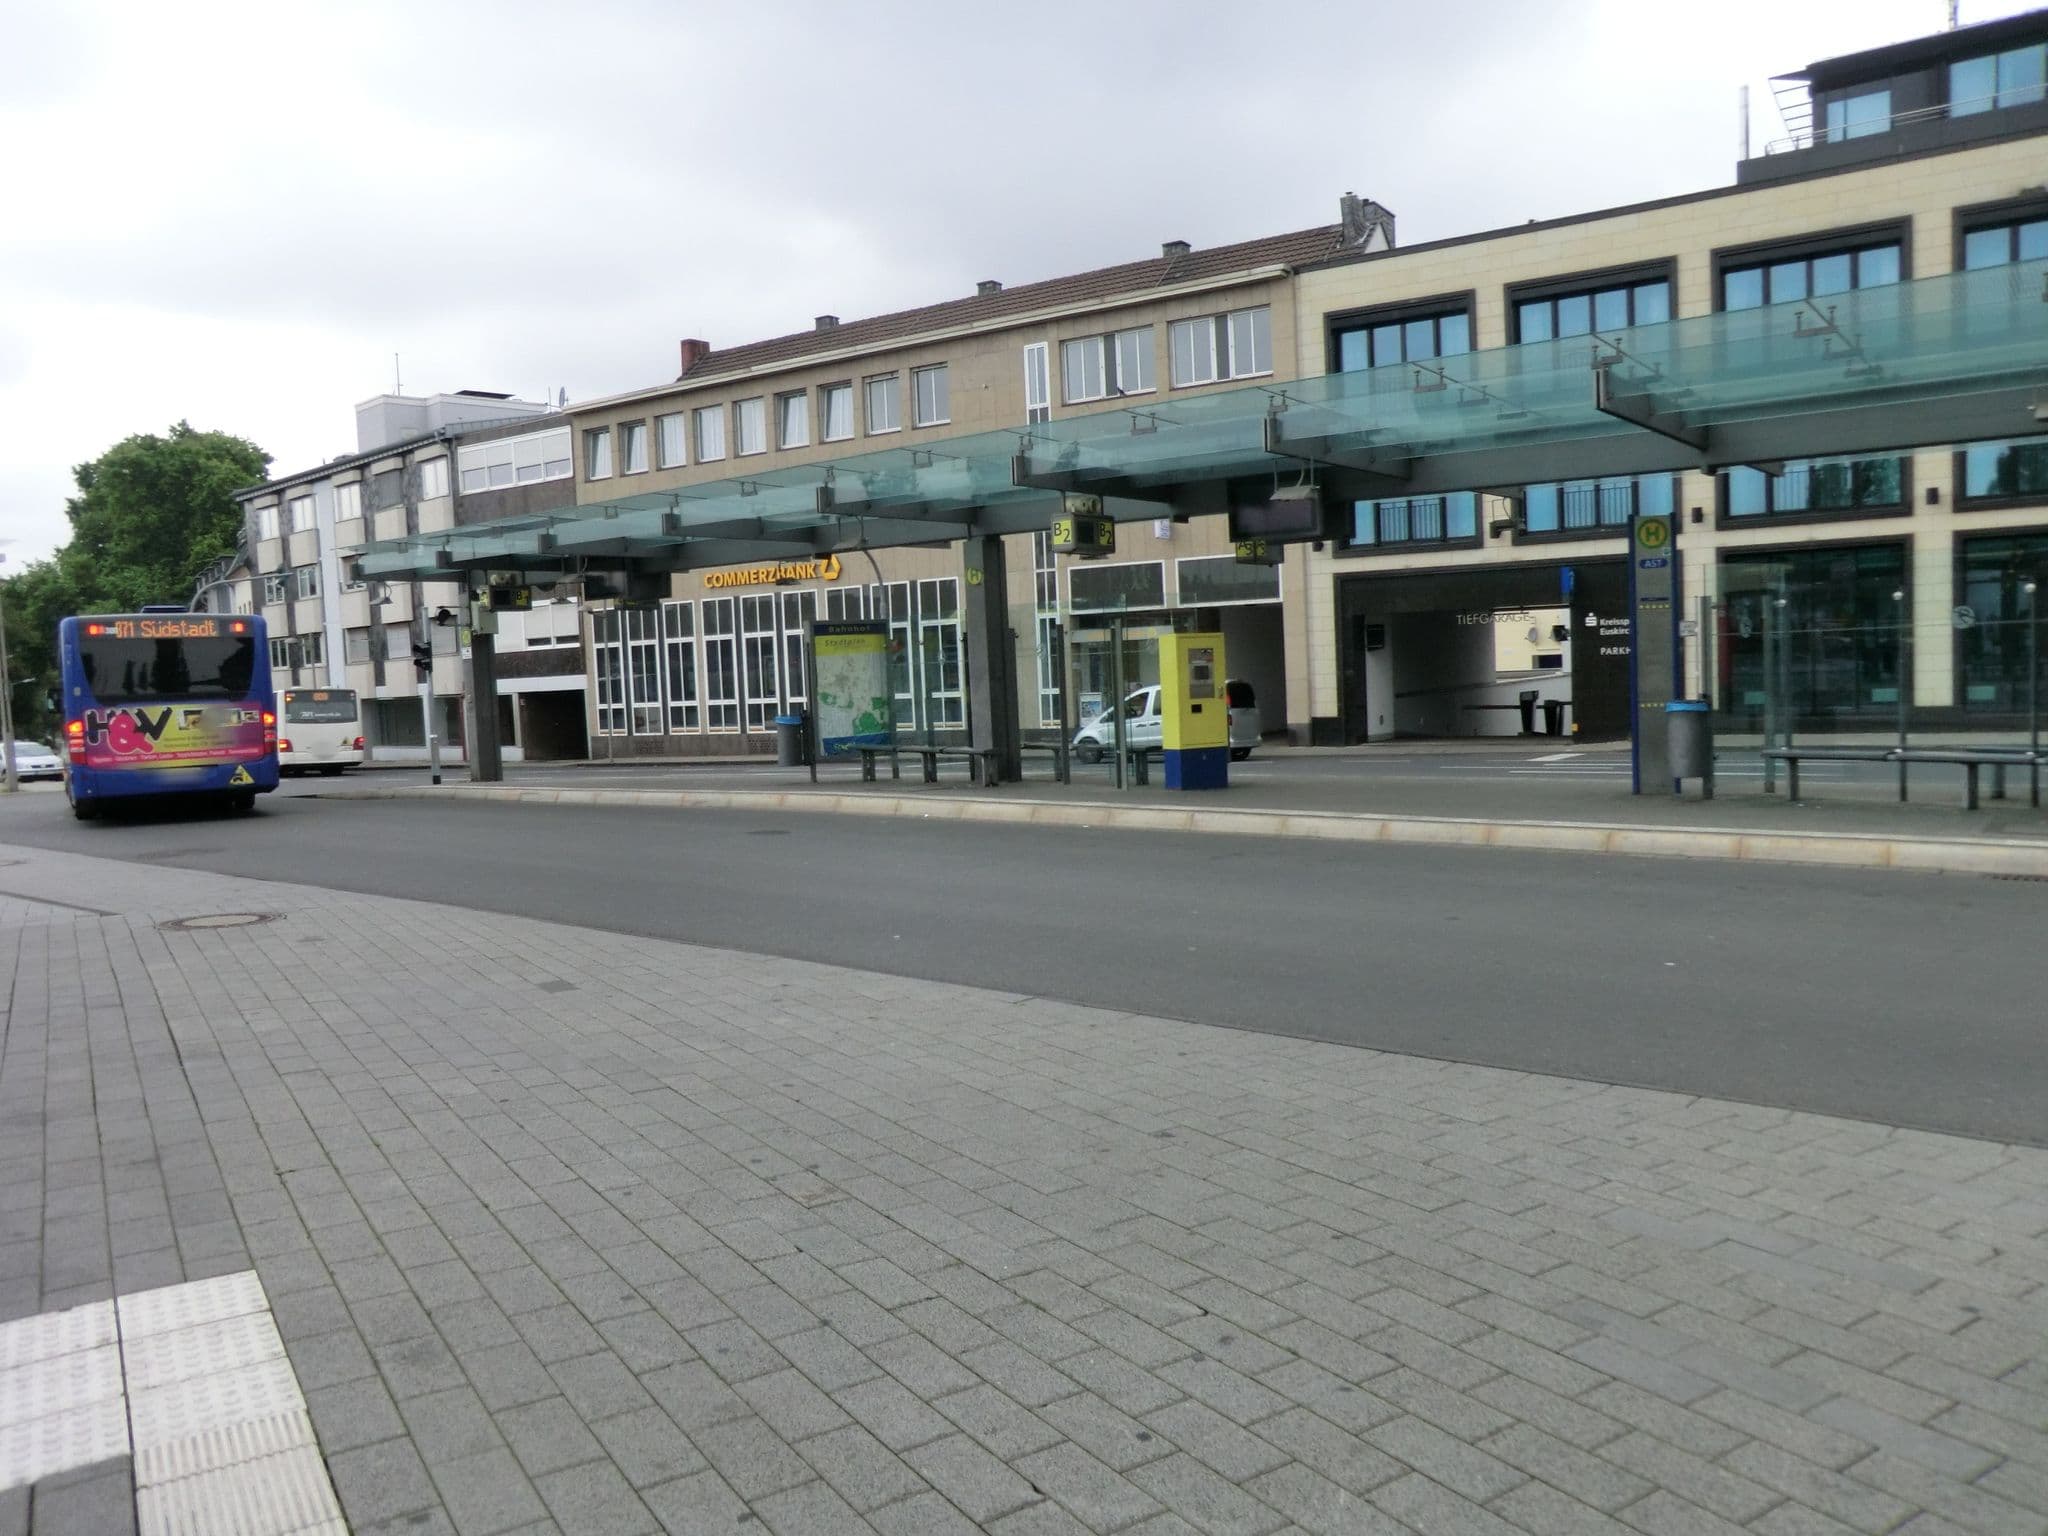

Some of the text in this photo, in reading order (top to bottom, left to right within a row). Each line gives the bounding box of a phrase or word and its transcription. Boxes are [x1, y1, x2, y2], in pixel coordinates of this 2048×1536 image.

[1053, 522, 1071, 543] B2
[1644, 559, 1662, 568] AST
[1456, 611, 1532, 625] TIEFGARAGE
[141, 619, 217, 638] Südstadt
